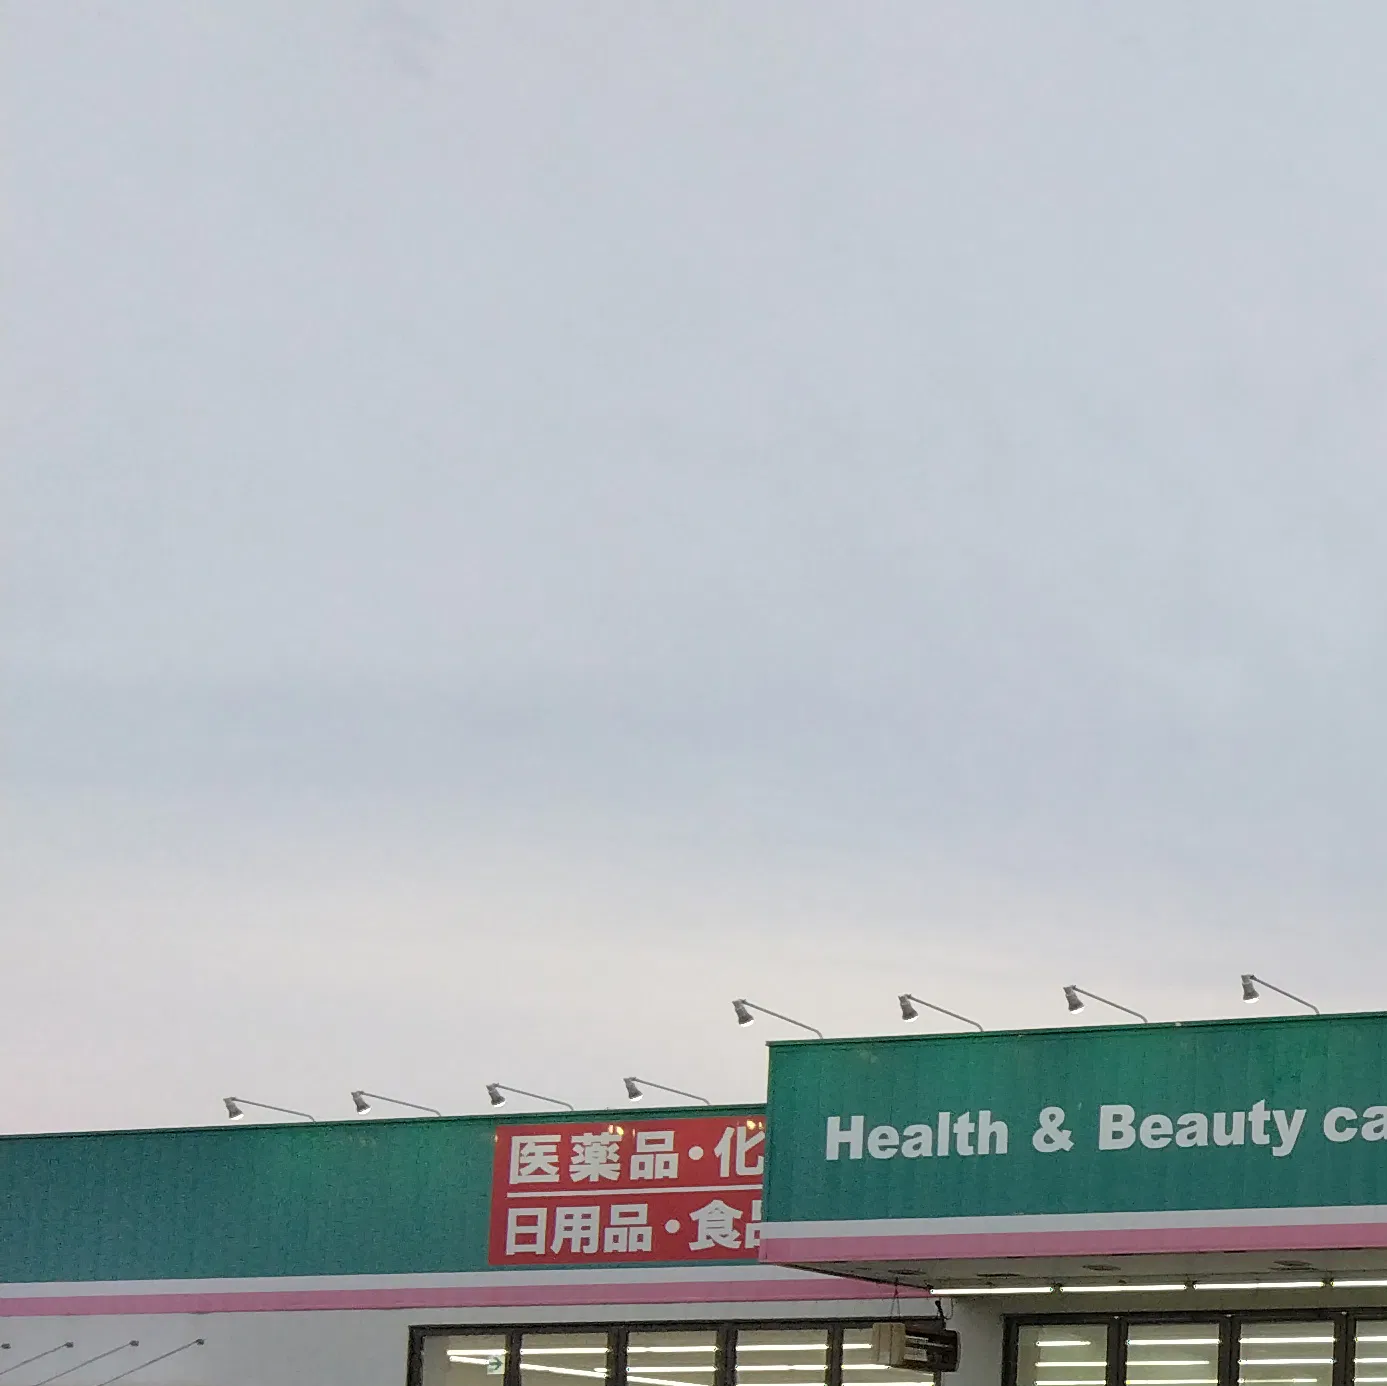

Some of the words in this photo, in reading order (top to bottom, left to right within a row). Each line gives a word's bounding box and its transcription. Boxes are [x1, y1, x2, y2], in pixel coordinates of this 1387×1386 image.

[510, 1127, 764, 1185] 医薬品・化
[825, 1110, 1008, 1160] Health
[1032, 1106, 1075, 1153] &
[1099, 1099, 1306, 1158] Beauty
